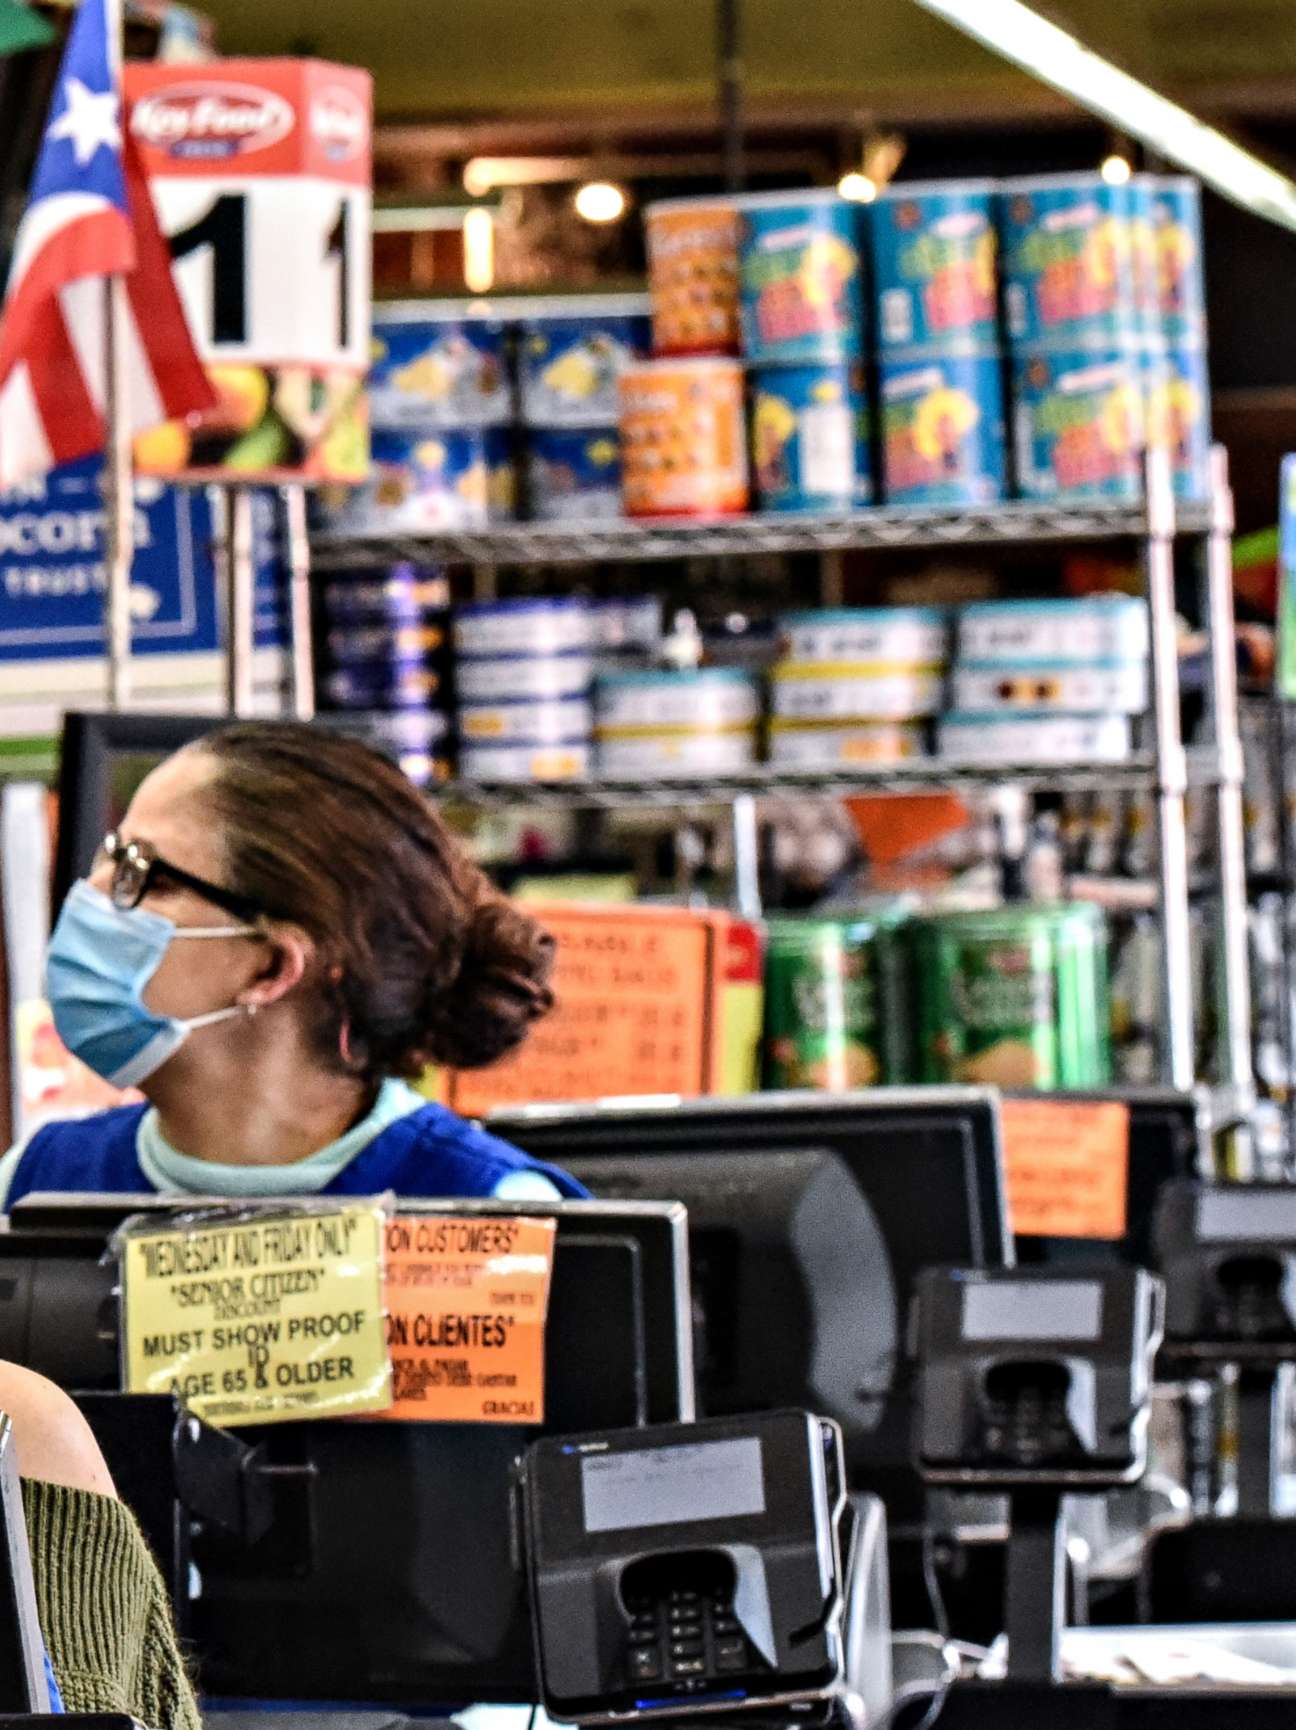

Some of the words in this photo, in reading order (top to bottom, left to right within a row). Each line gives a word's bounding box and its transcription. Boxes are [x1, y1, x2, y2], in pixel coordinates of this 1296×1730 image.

[168, 194, 245, 343] 1
[143, 1330, 203, 1357] MUST
[212, 1322, 281, 1350] SHOW
[288, 1310, 365, 1340] PROOF
[170, 1373, 216, 1398] AGE
[222, 1370, 247, 1393] 65
[276, 1357, 354, 1387] OLDER
